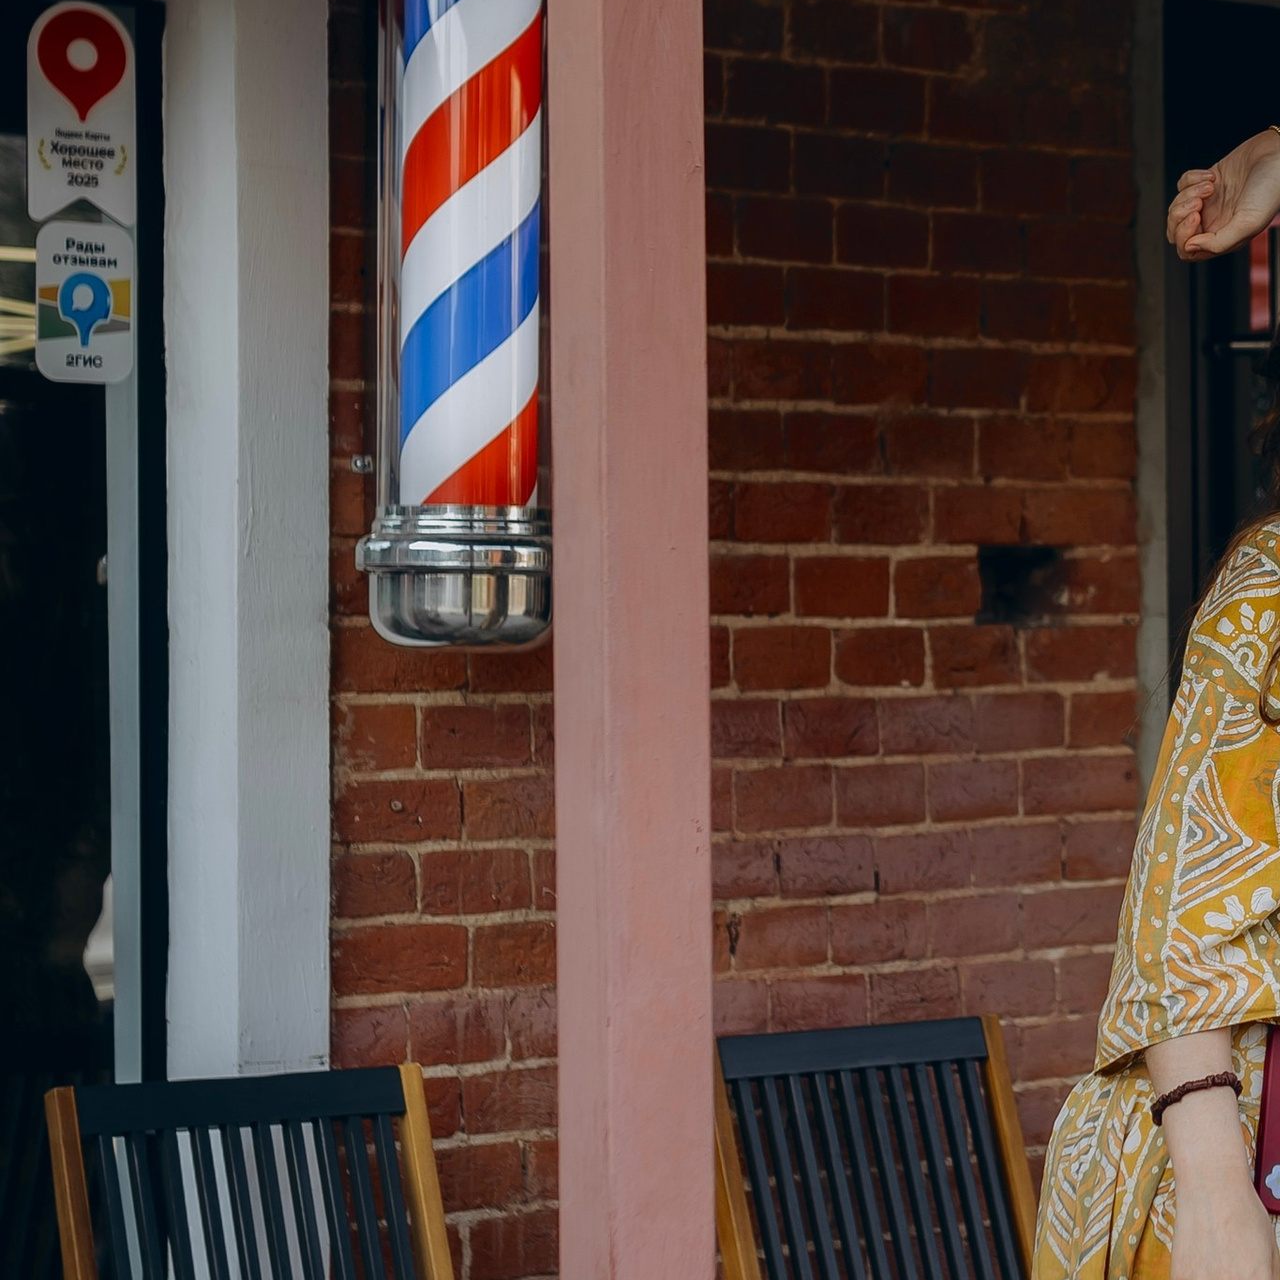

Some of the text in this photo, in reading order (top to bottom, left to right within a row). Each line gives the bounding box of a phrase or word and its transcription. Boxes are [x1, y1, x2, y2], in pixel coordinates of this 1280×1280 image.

[50, 140, 115, 159] Хорошее
[67, 172, 99, 188] 2025
[65, 237, 105, 254] Рады
[53, 253, 118, 269] отзывам
[65, 353, 103, 368] 2ГИС
